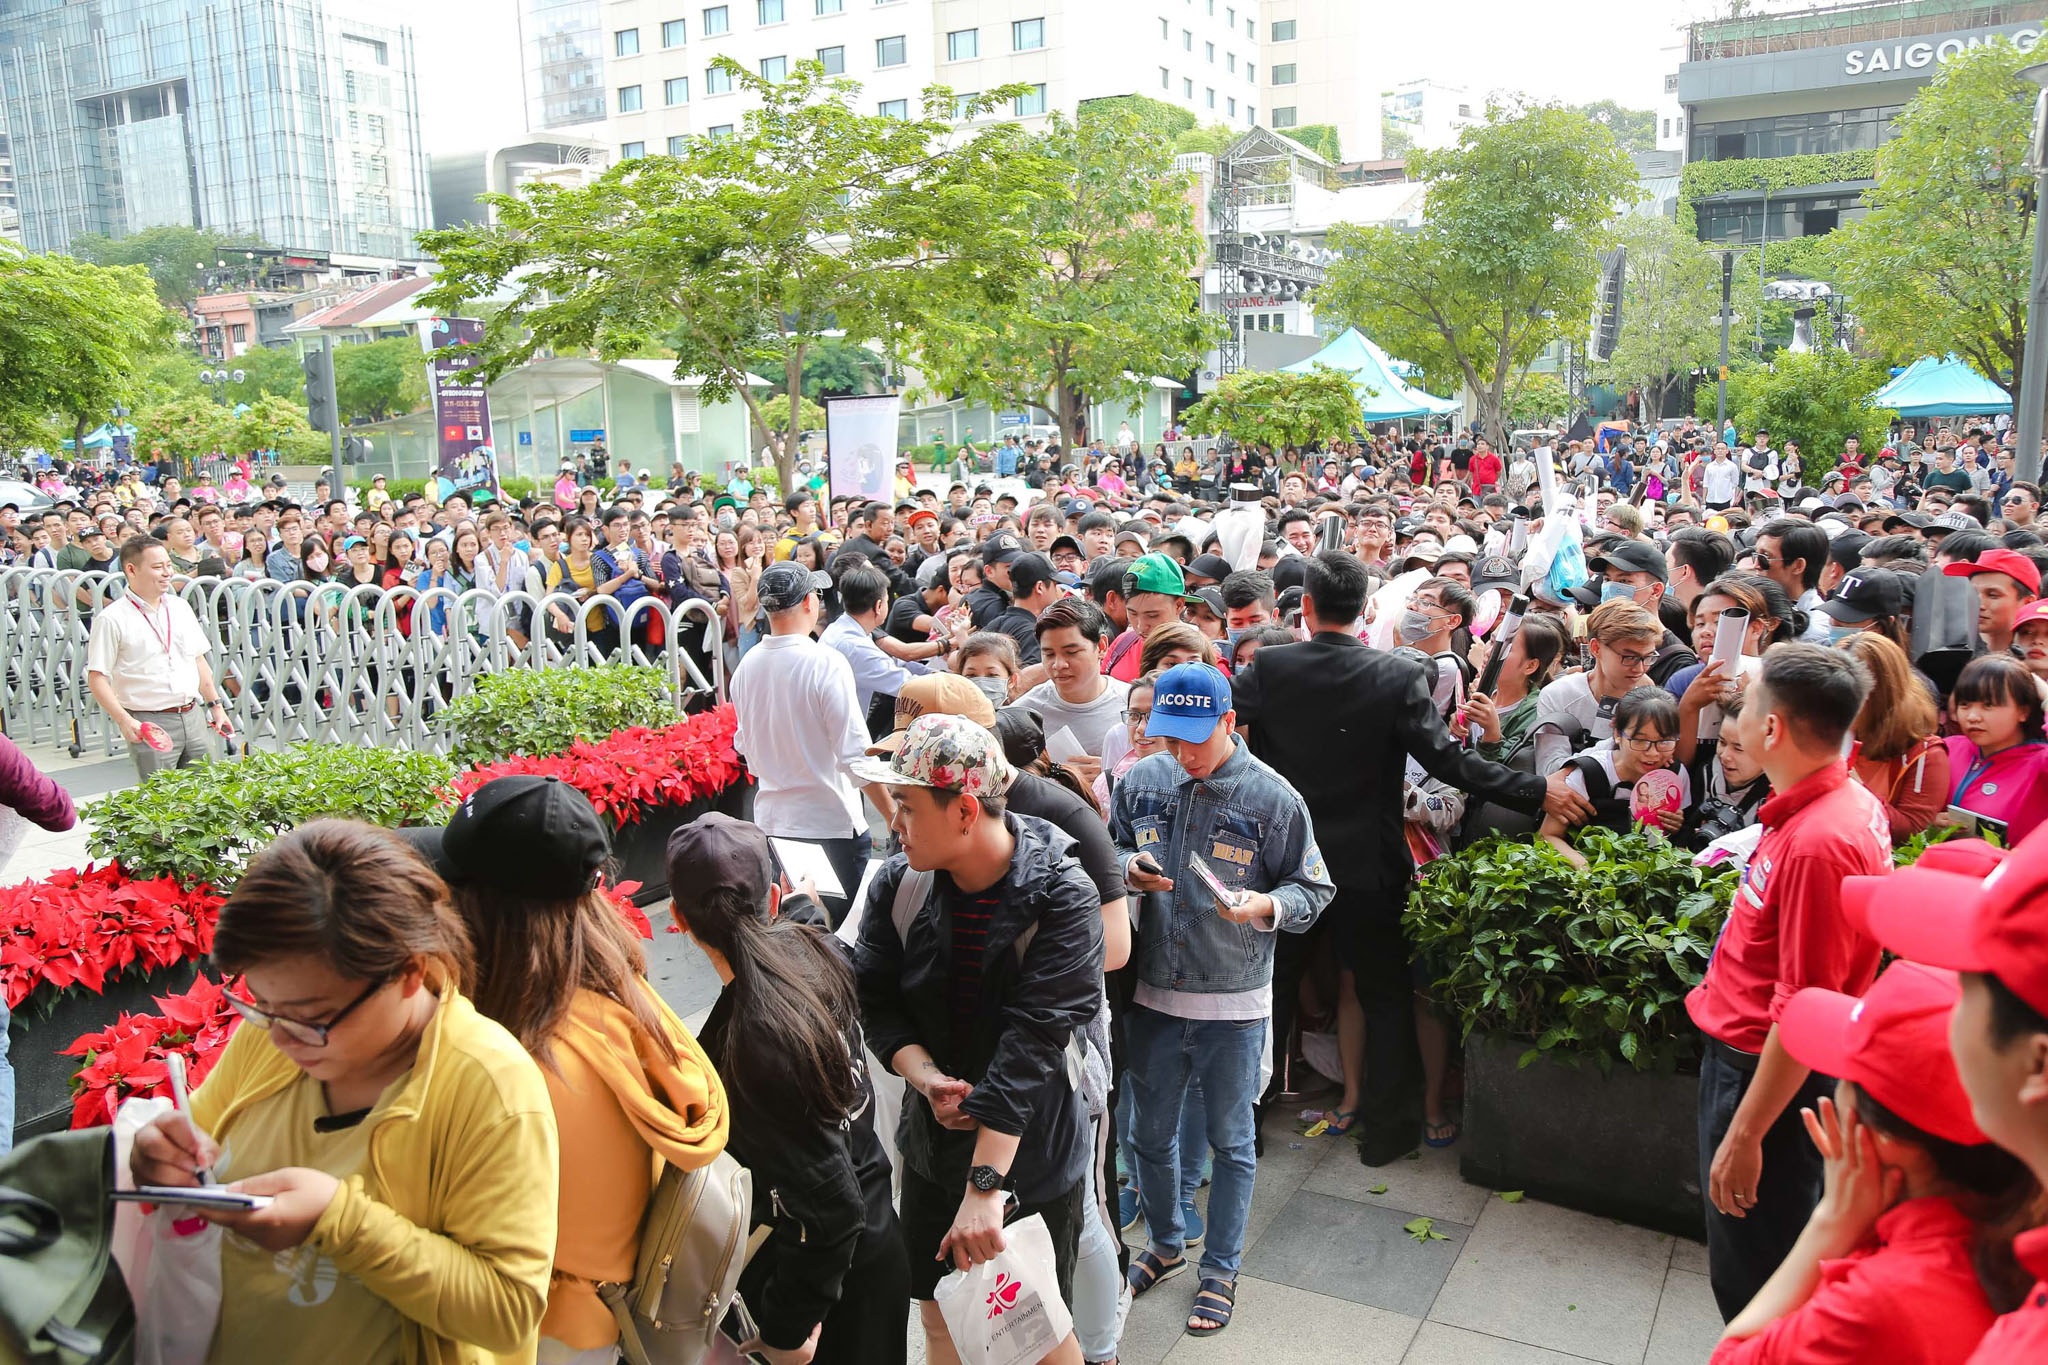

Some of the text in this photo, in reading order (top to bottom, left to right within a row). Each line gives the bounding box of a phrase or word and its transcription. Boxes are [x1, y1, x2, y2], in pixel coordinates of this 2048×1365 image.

[1845, 34, 1993, 75] SAIGON
[1836, 575, 1863, 599] T
[1156, 693, 1211, 708] LACOSTE
